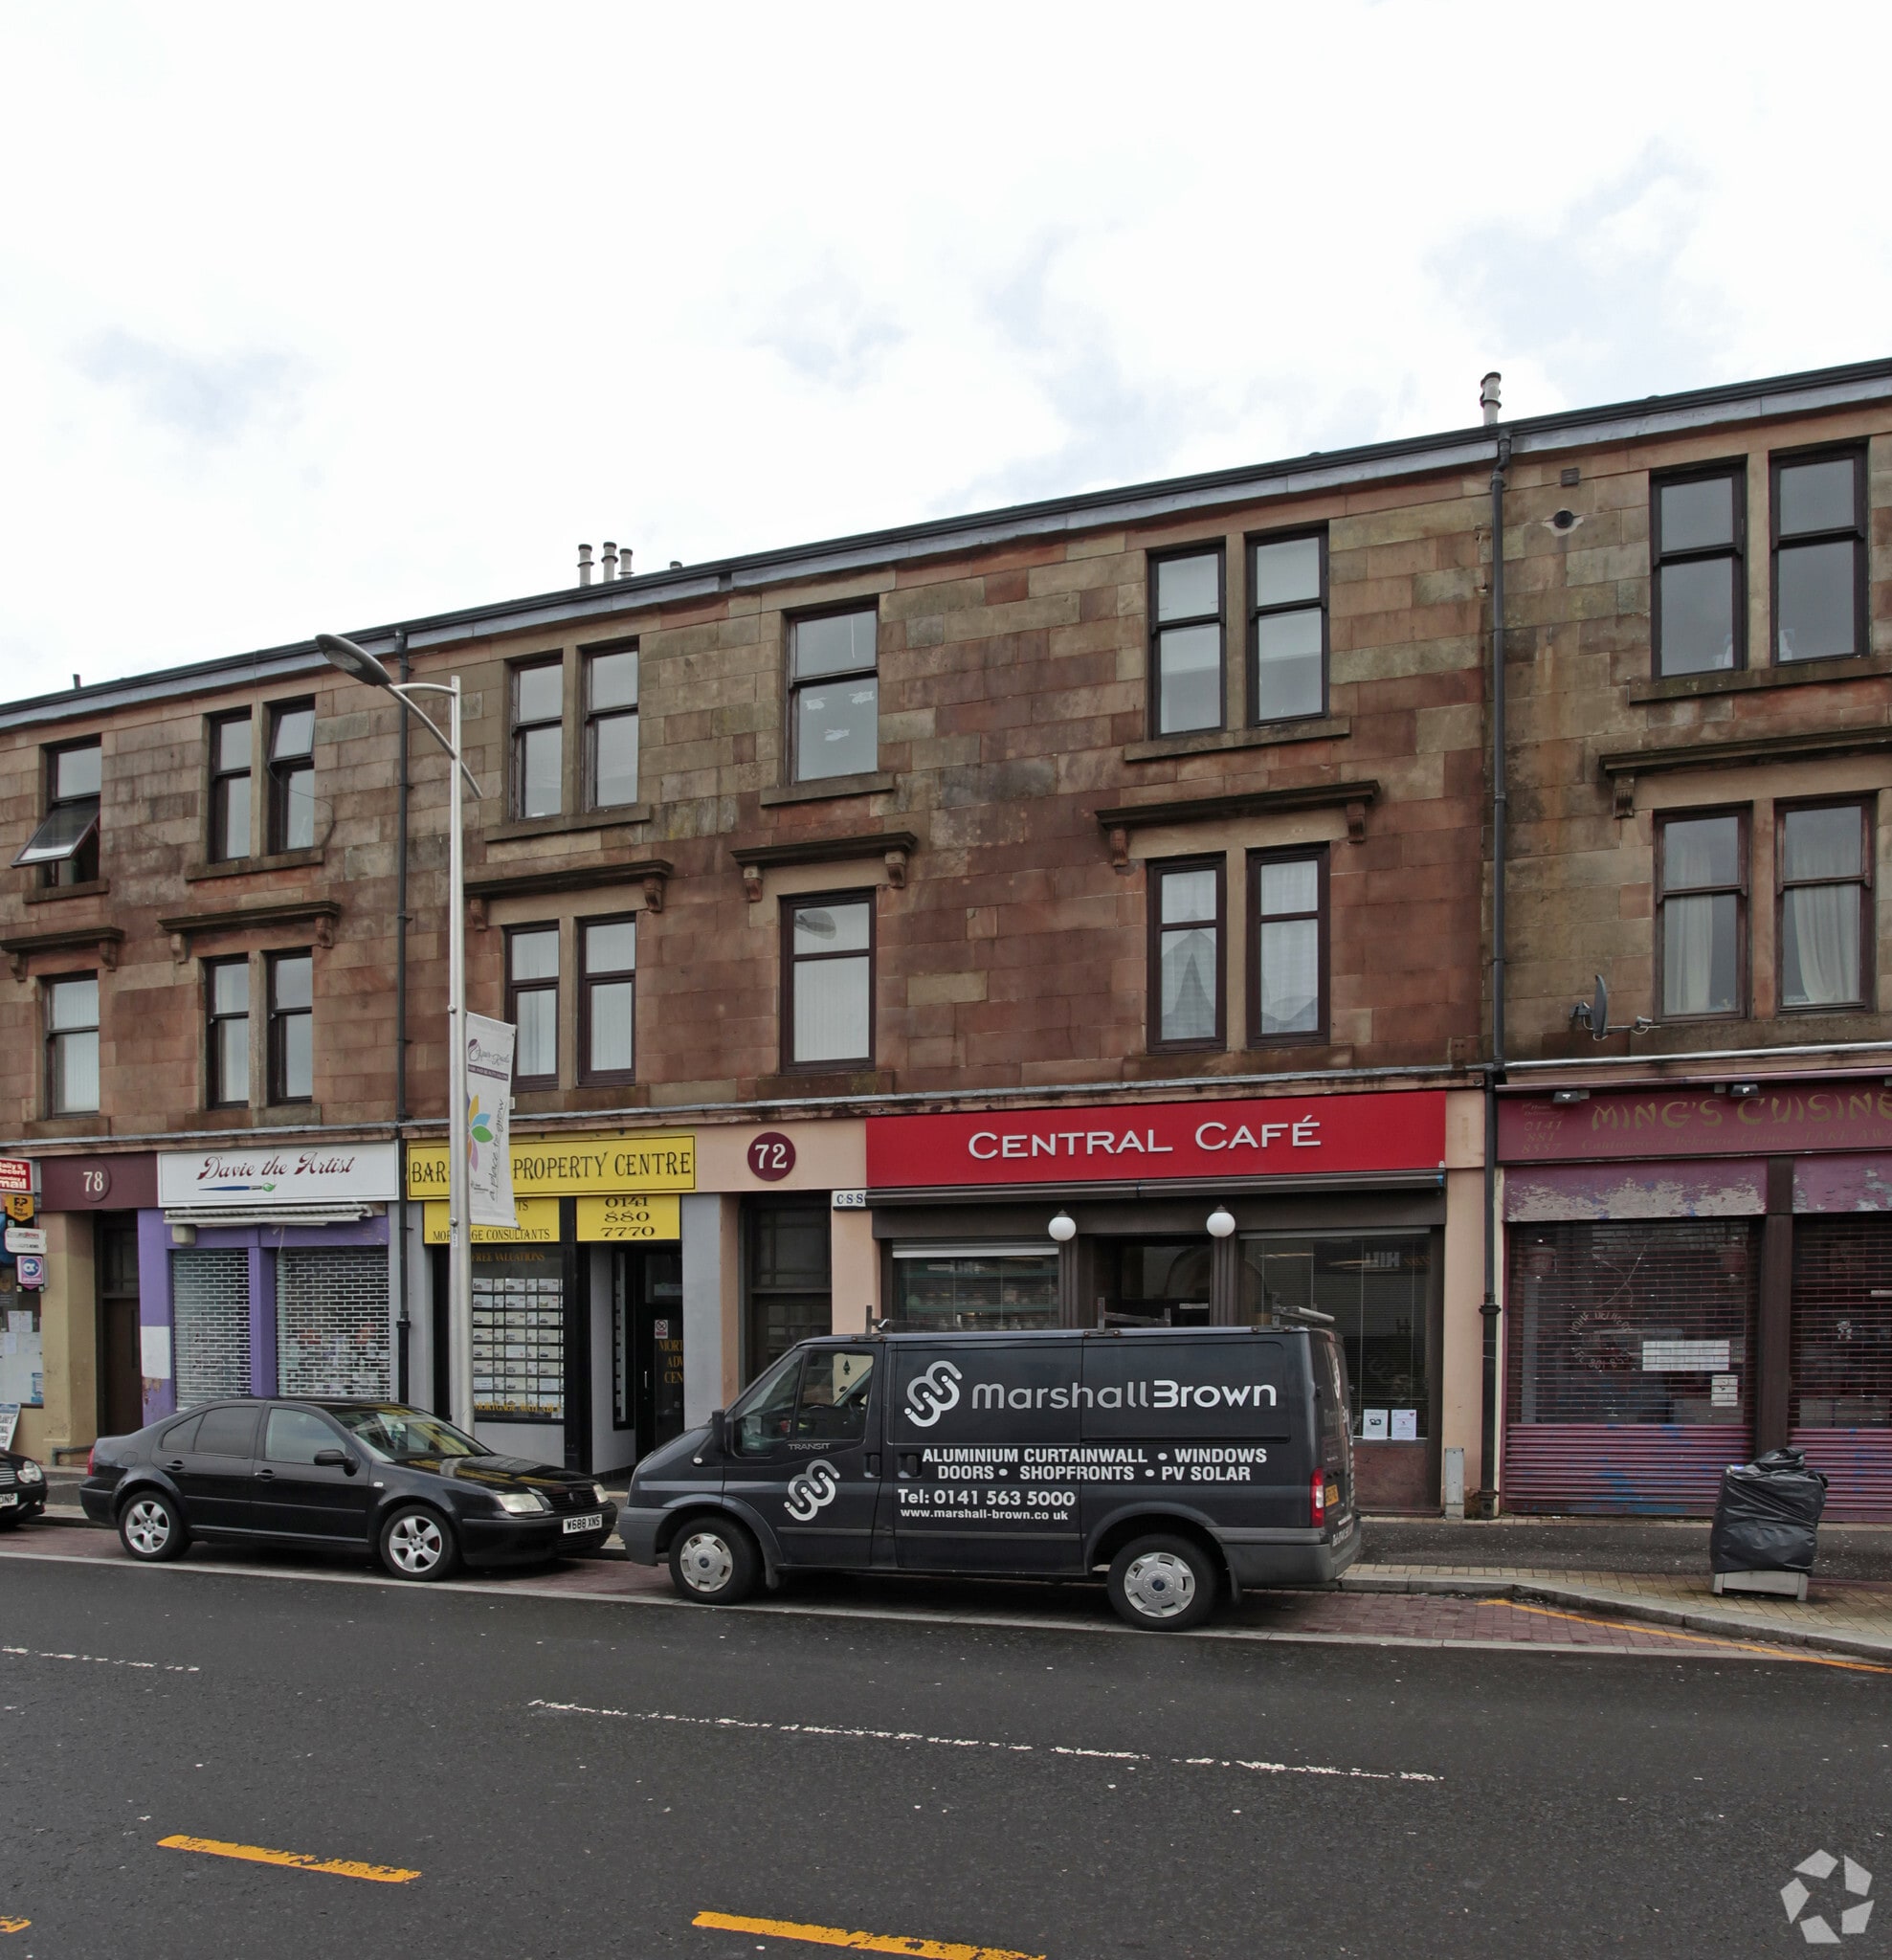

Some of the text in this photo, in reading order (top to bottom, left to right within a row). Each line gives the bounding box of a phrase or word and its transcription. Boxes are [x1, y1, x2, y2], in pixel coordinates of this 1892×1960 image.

[1592, 1092, 1892, 1131] MING'S CUISINE
[968, 1115, 1321, 1160] CENTRAL CAFÉ
[755, 1143, 788, 1169] 72
[197, 1151, 356, 1181] Davie the Artist
[513, 1151, 609, 1180] PROPERTY
[614, 1151, 691, 1176] CENTRE
[83, 1170, 104, 1192] 78
[605, 1196, 649, 1208] 0141
[605, 1211, 650, 1223] 880
[487, 1228, 550, 1241] CONSULTANTS
[600, 1226, 656, 1238] 7770
[658, 1340, 683, 1351] MORT
[666, 1355, 683, 1368] ADV
[663, 1371, 683, 1384] CEN
[788, 1442, 831, 1451] TRANSIT
[923, 1448, 1267, 1463] ALUMINIUM CURTAINWALL WINDOWS
[938, 1465, 1251, 1481] DOORS SHOPFRONTS PV SOLAR
[898, 1489, 1076, 1506] Tel: 0141 563 5000
